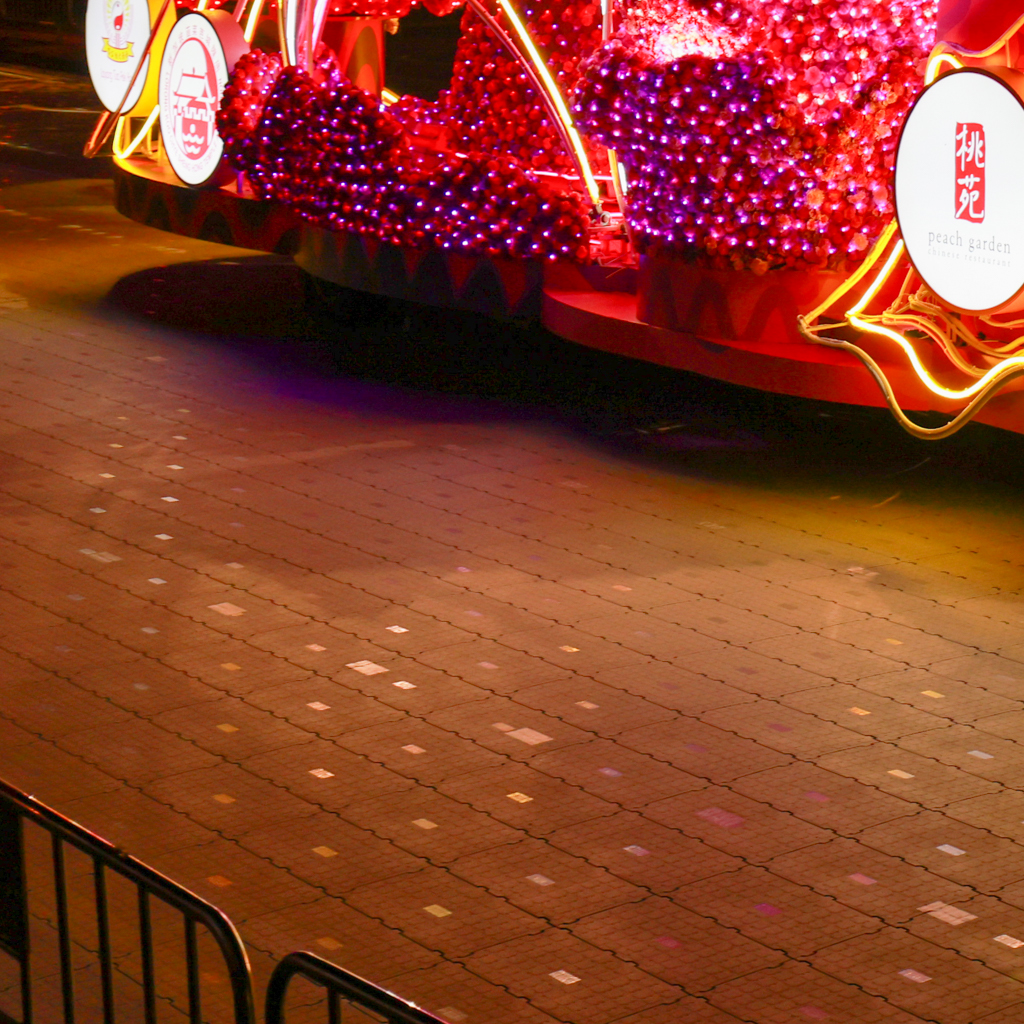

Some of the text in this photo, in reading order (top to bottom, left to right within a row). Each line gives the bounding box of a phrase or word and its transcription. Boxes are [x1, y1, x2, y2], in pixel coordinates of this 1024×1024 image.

[955, 123, 986, 219] 桃苑
[928, 229, 1011, 254] peach garden
[927, 246, 1011, 267] chinese restaurant
